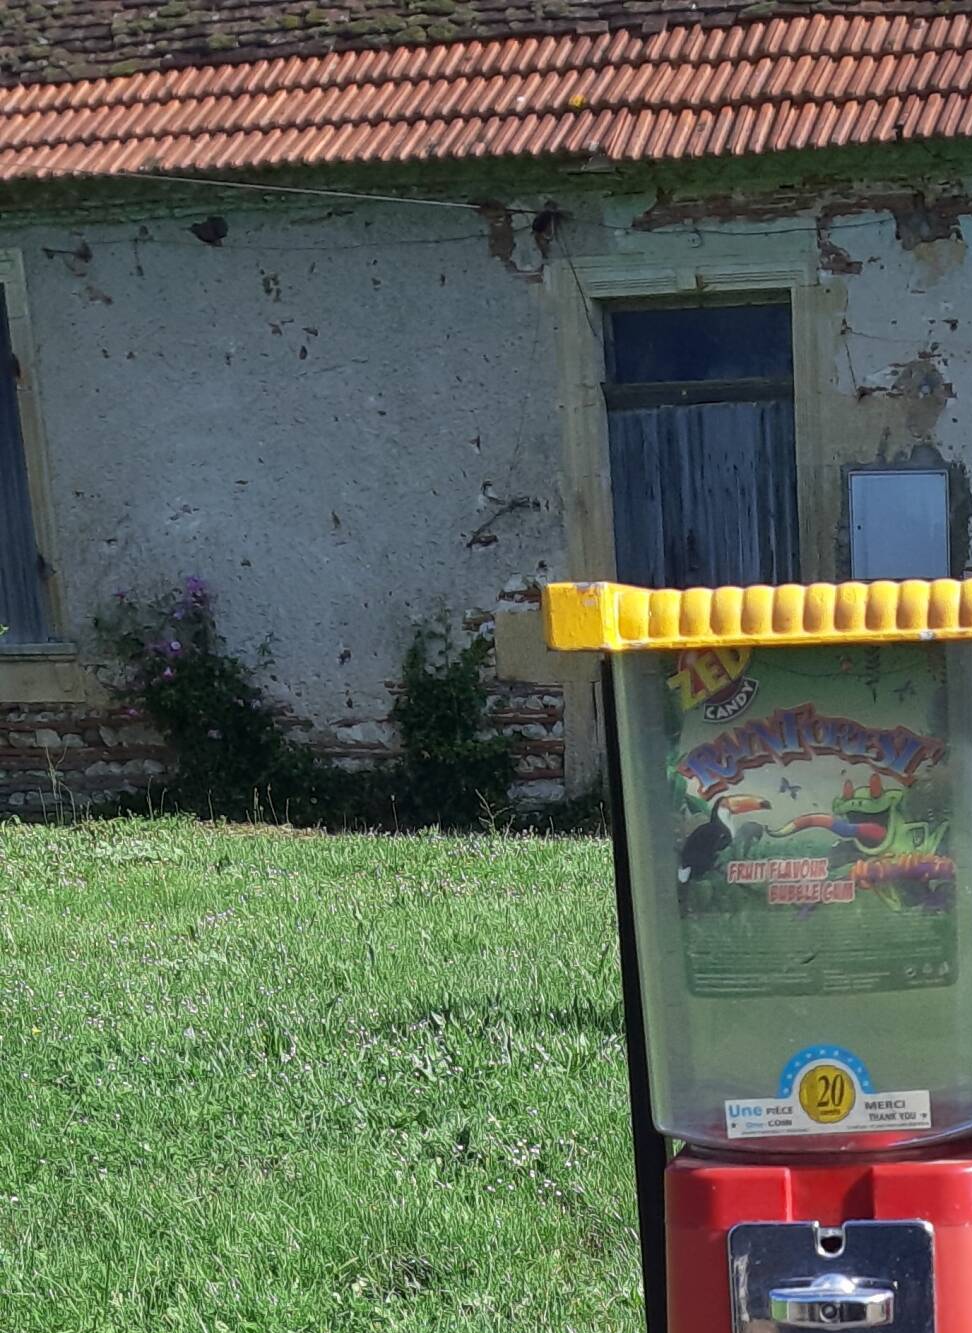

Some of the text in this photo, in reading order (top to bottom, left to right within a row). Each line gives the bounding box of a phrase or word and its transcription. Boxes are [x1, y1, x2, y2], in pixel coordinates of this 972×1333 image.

[666, 647, 752, 713] ZED
[706, 681, 753, 719] CANDY
[678, 702, 946, 801] RAINFOREST
[728, 858, 828, 882] FRUIT FLAVOUR
[769, 881, 855, 903] BUBBLE GUM
[817, 1074, 845, 1108] 20
[728, 1104, 763, 1118] Une
[864, 1100, 906, 1111] MERCI
[868, 1111, 916, 1122] THANK YOU
